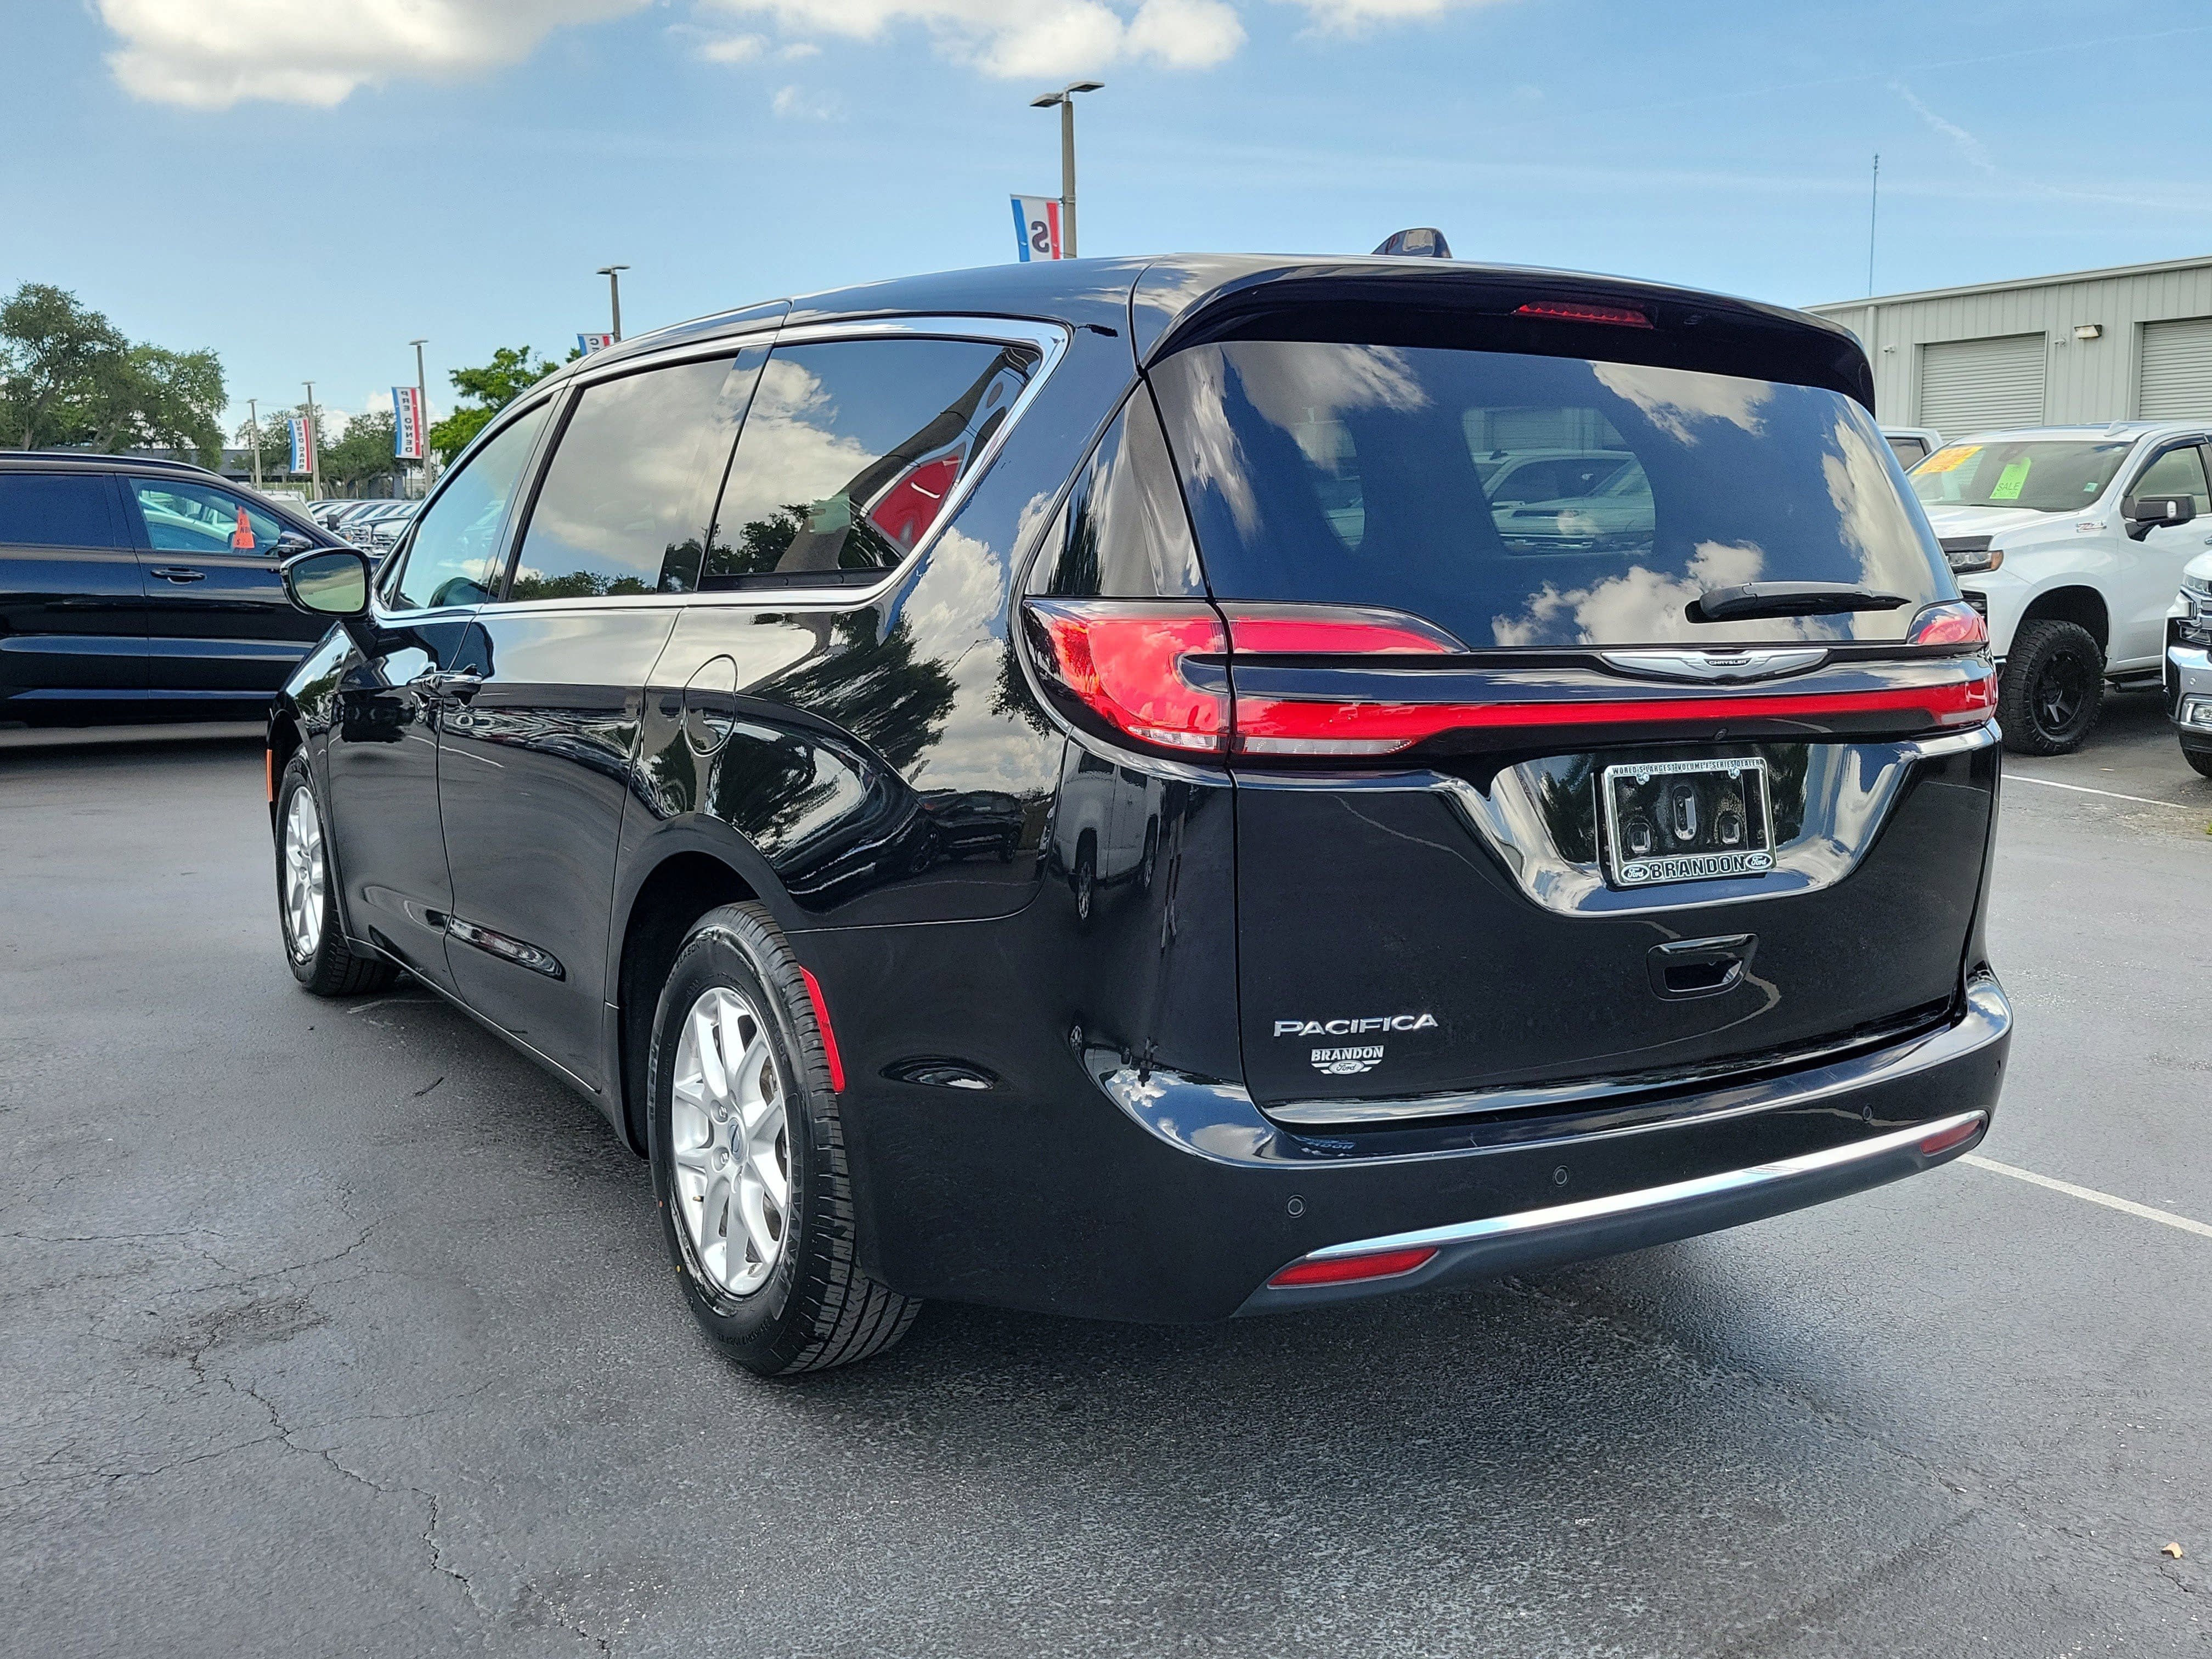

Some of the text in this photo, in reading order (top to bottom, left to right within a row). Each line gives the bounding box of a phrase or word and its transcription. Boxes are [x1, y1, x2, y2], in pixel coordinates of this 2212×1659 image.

[1997, 482, 2021, 492] SALE
[1645, 763, 1675, 773] LARGEST
[1627, 855, 1767, 879] Ford BRANDON Ford
[1273, 1013, 1439, 1037] PACIFICA
[1311, 1045, 1384, 1062] BRANDON
[1336, 1062, 1357, 1071] Ford
